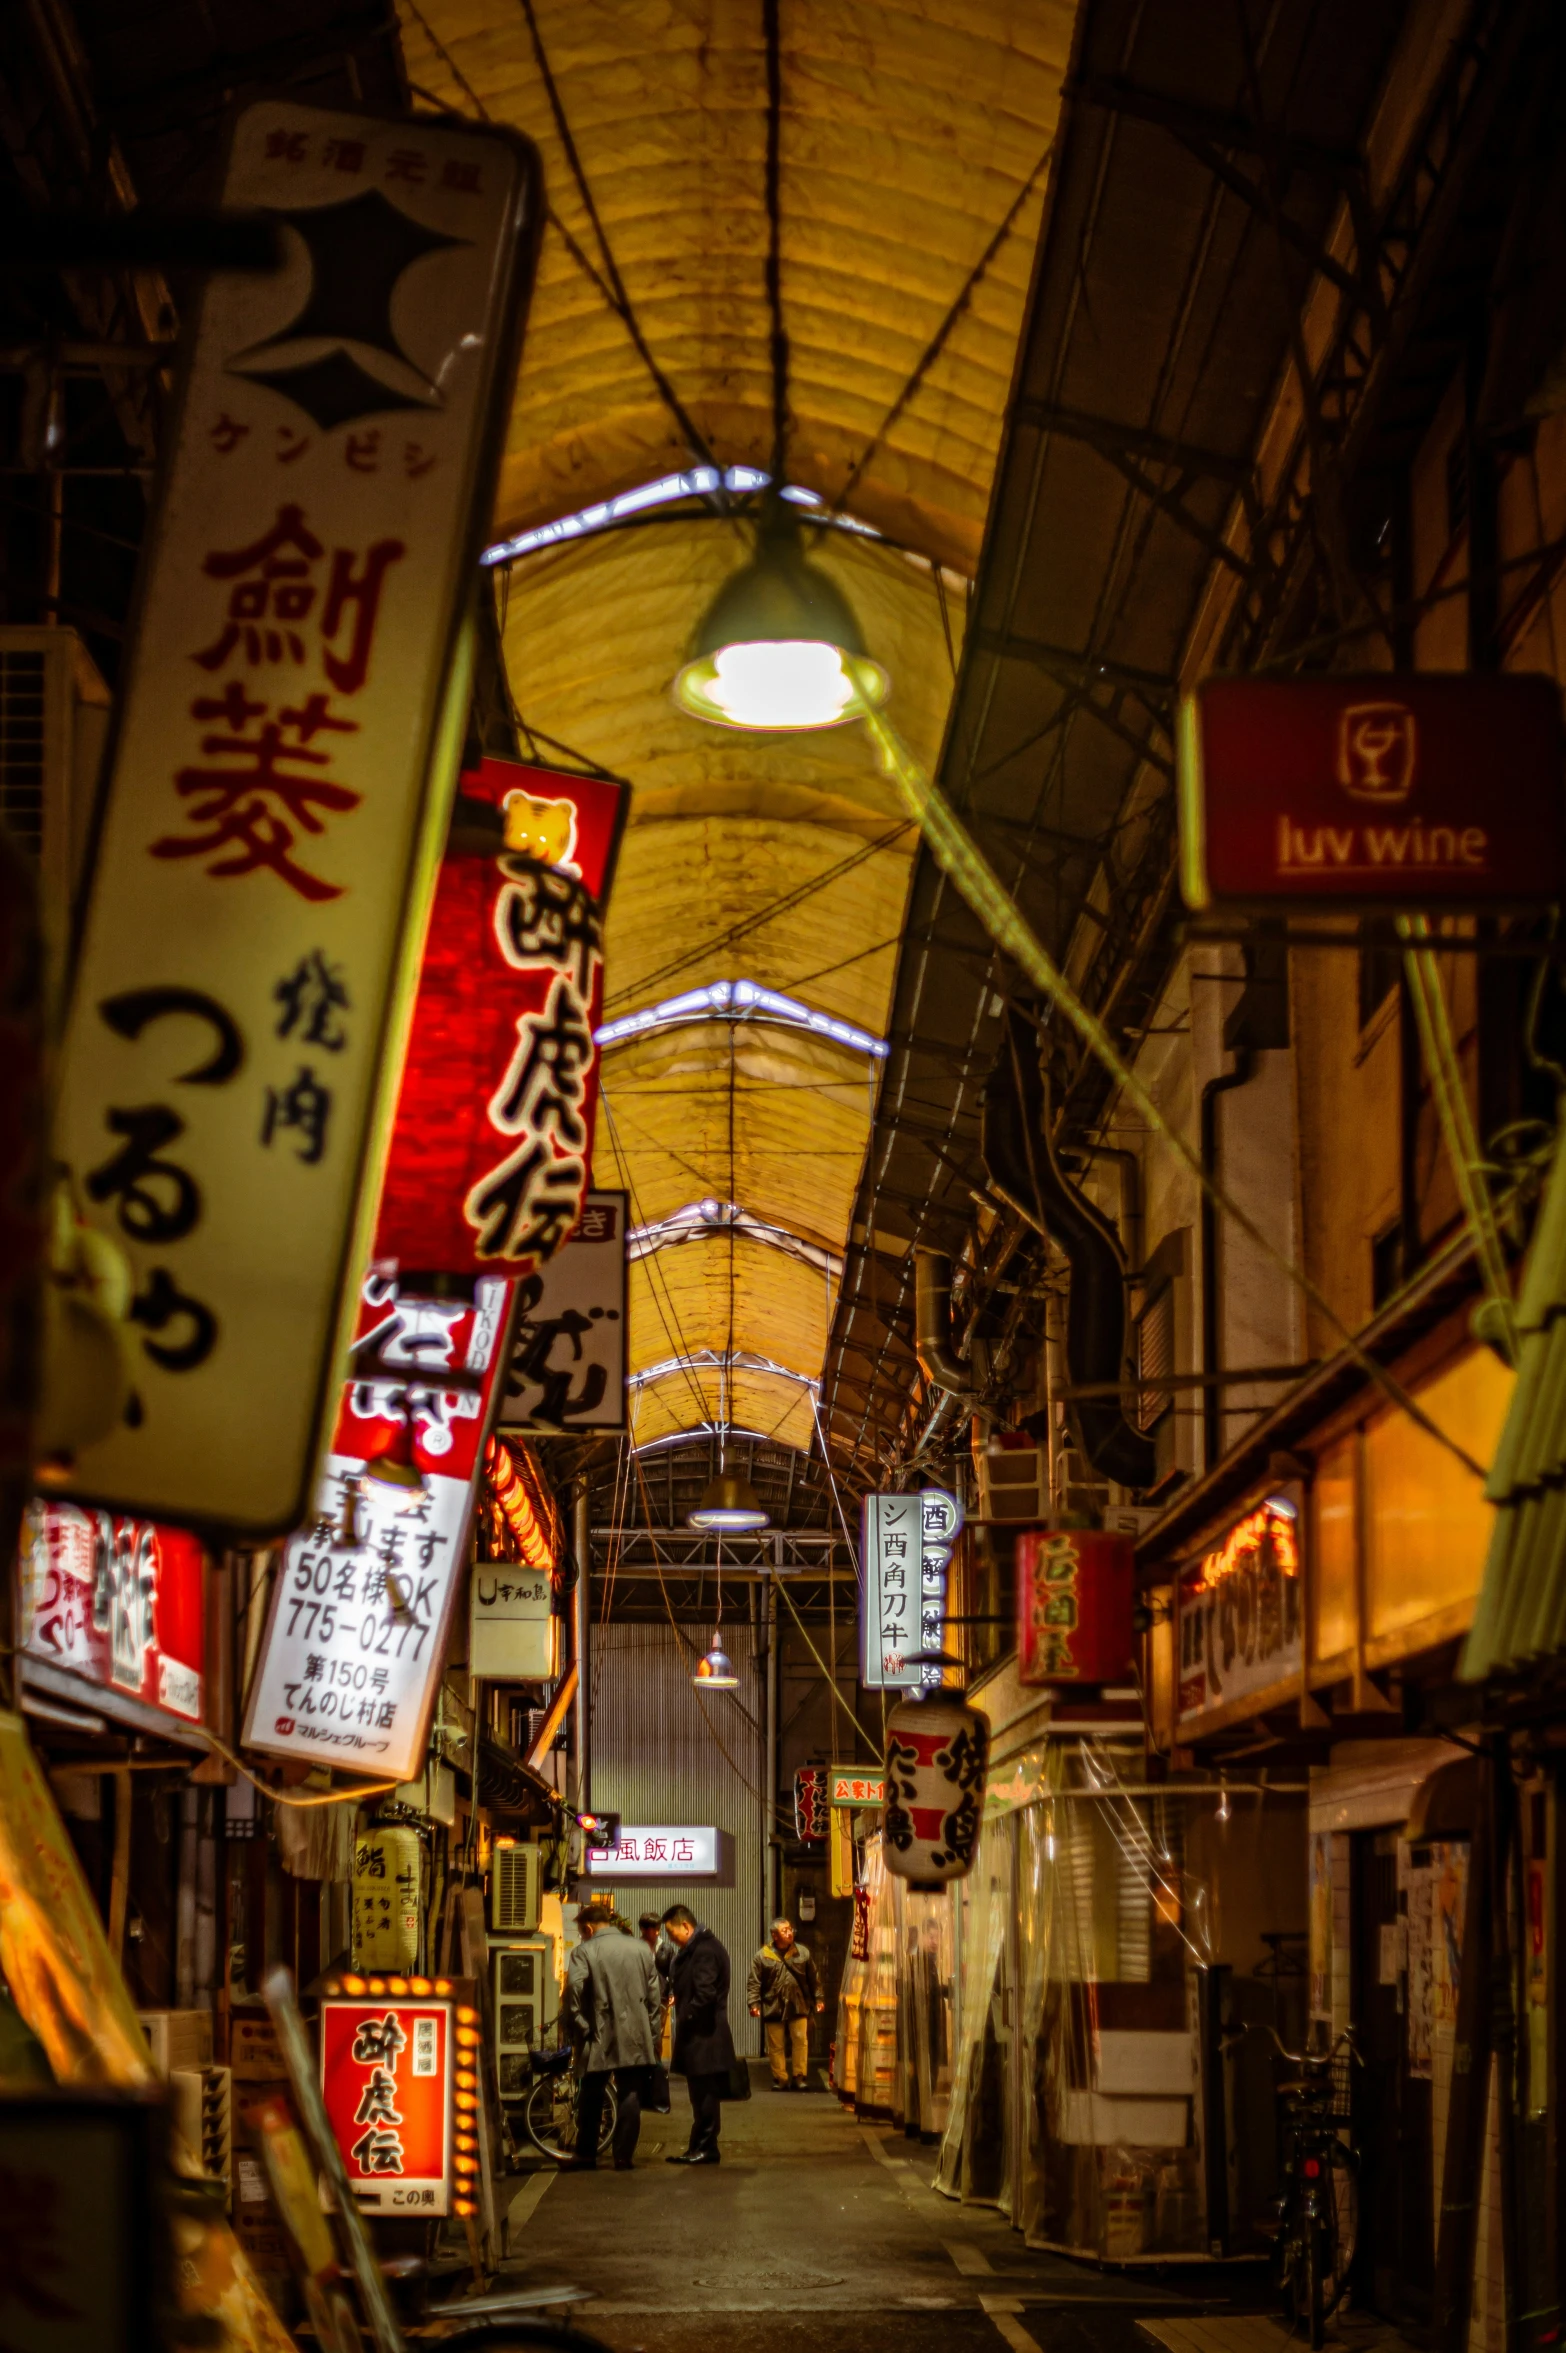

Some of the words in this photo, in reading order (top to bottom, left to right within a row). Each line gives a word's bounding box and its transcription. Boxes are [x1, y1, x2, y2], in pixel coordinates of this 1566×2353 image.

[210, 412, 436, 478] ケンビシ
[1278, 814, 1353, 864] luv
[1366, 816, 1488, 864] wine
[498, 1583, 547, 1603] 宇和島
[287, 1598, 430, 1662] 775-0277
[284, 1683, 398, 1730] てんのじ村店
[296, 1723, 391, 1753] マルシェグループ
[352, 2011, 408, 2175] 酔虎伝
[392, 2189, 436, 2207] この奥
